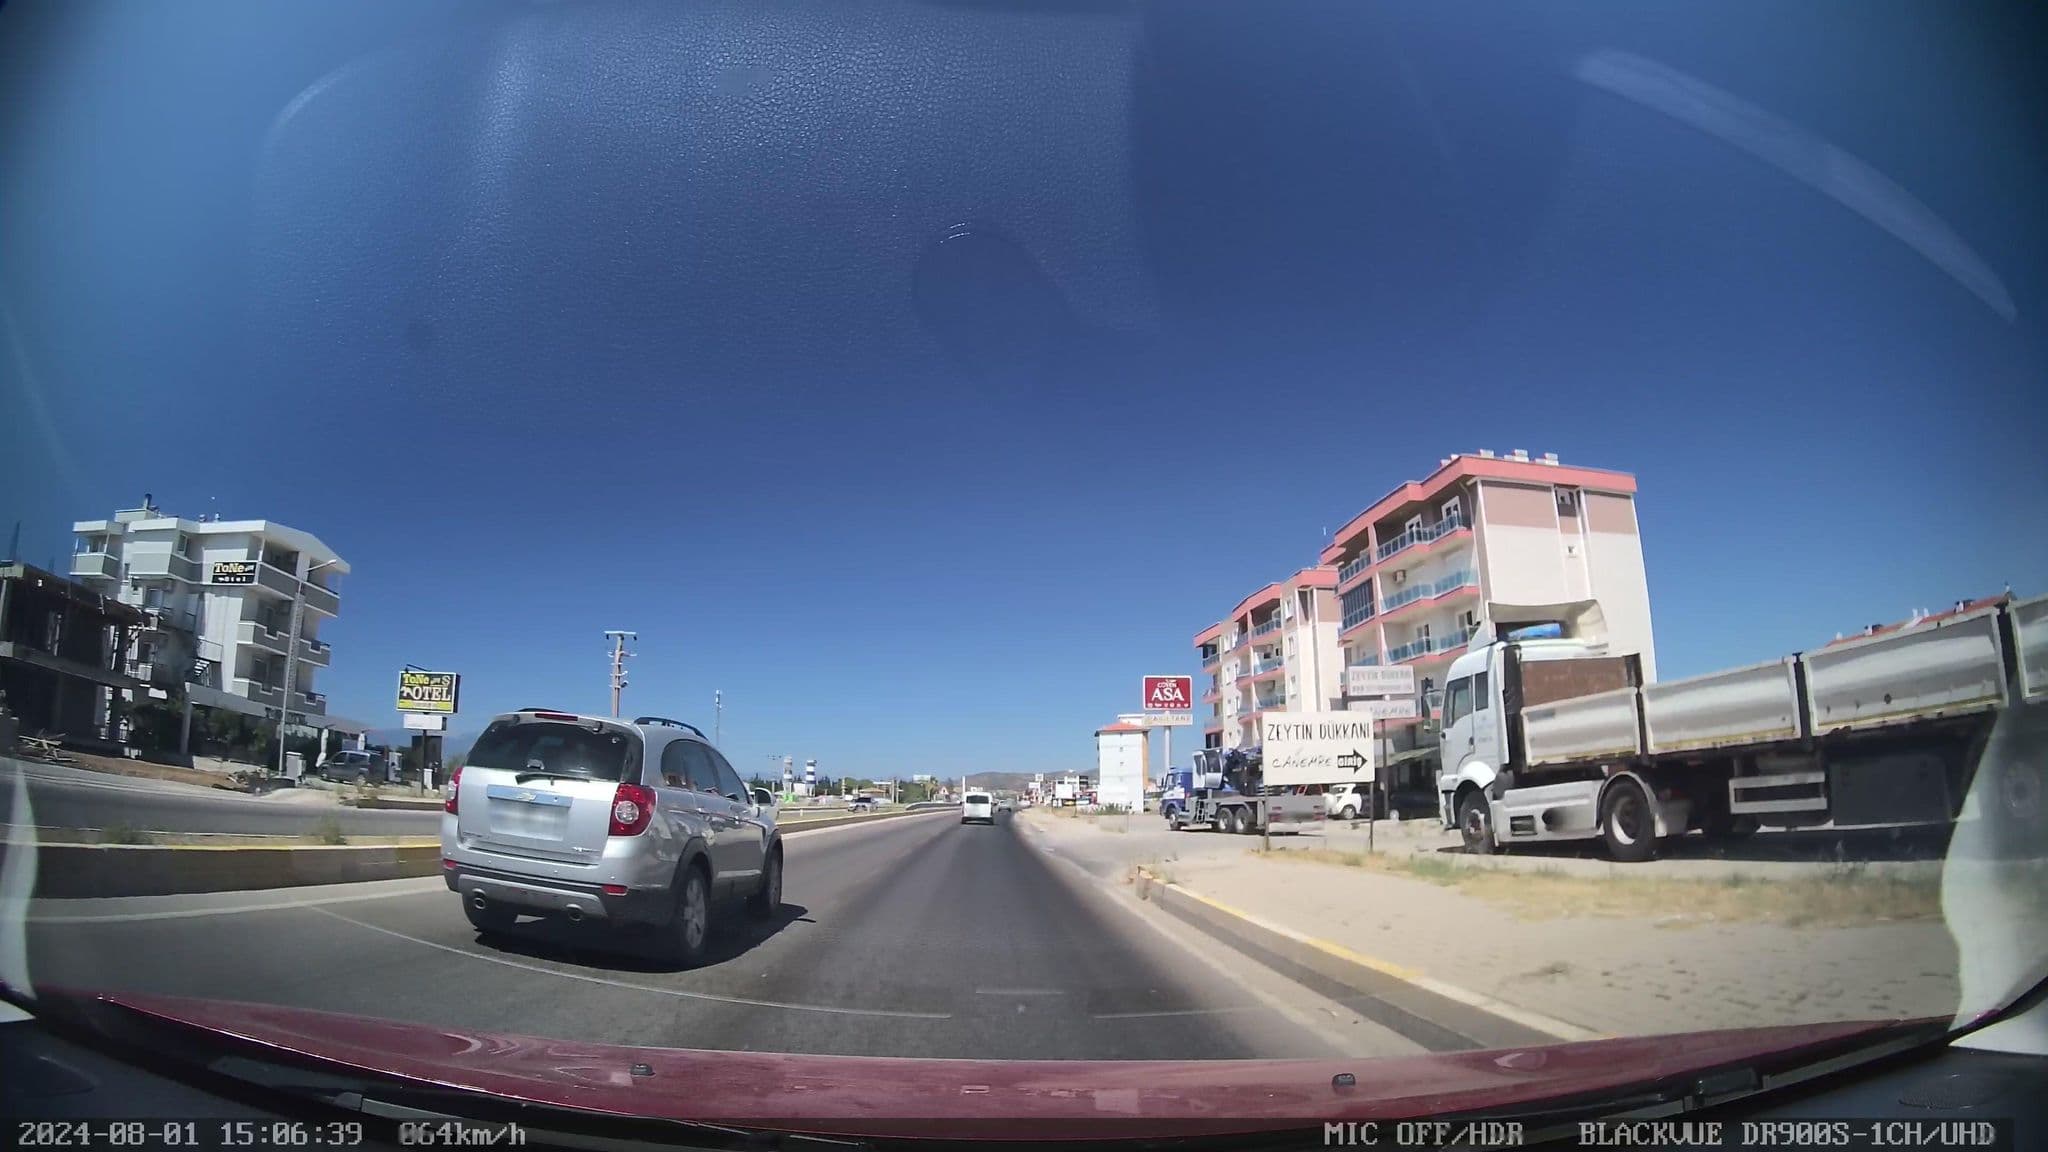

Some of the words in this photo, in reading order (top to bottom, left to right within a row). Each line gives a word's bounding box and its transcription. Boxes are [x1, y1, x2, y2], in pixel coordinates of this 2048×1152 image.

[1151, 687, 1185, 701] ASA
[1267, 722, 1313, 741] ZEYTİN
[1319, 721, 1370, 740] DÜKKANI
